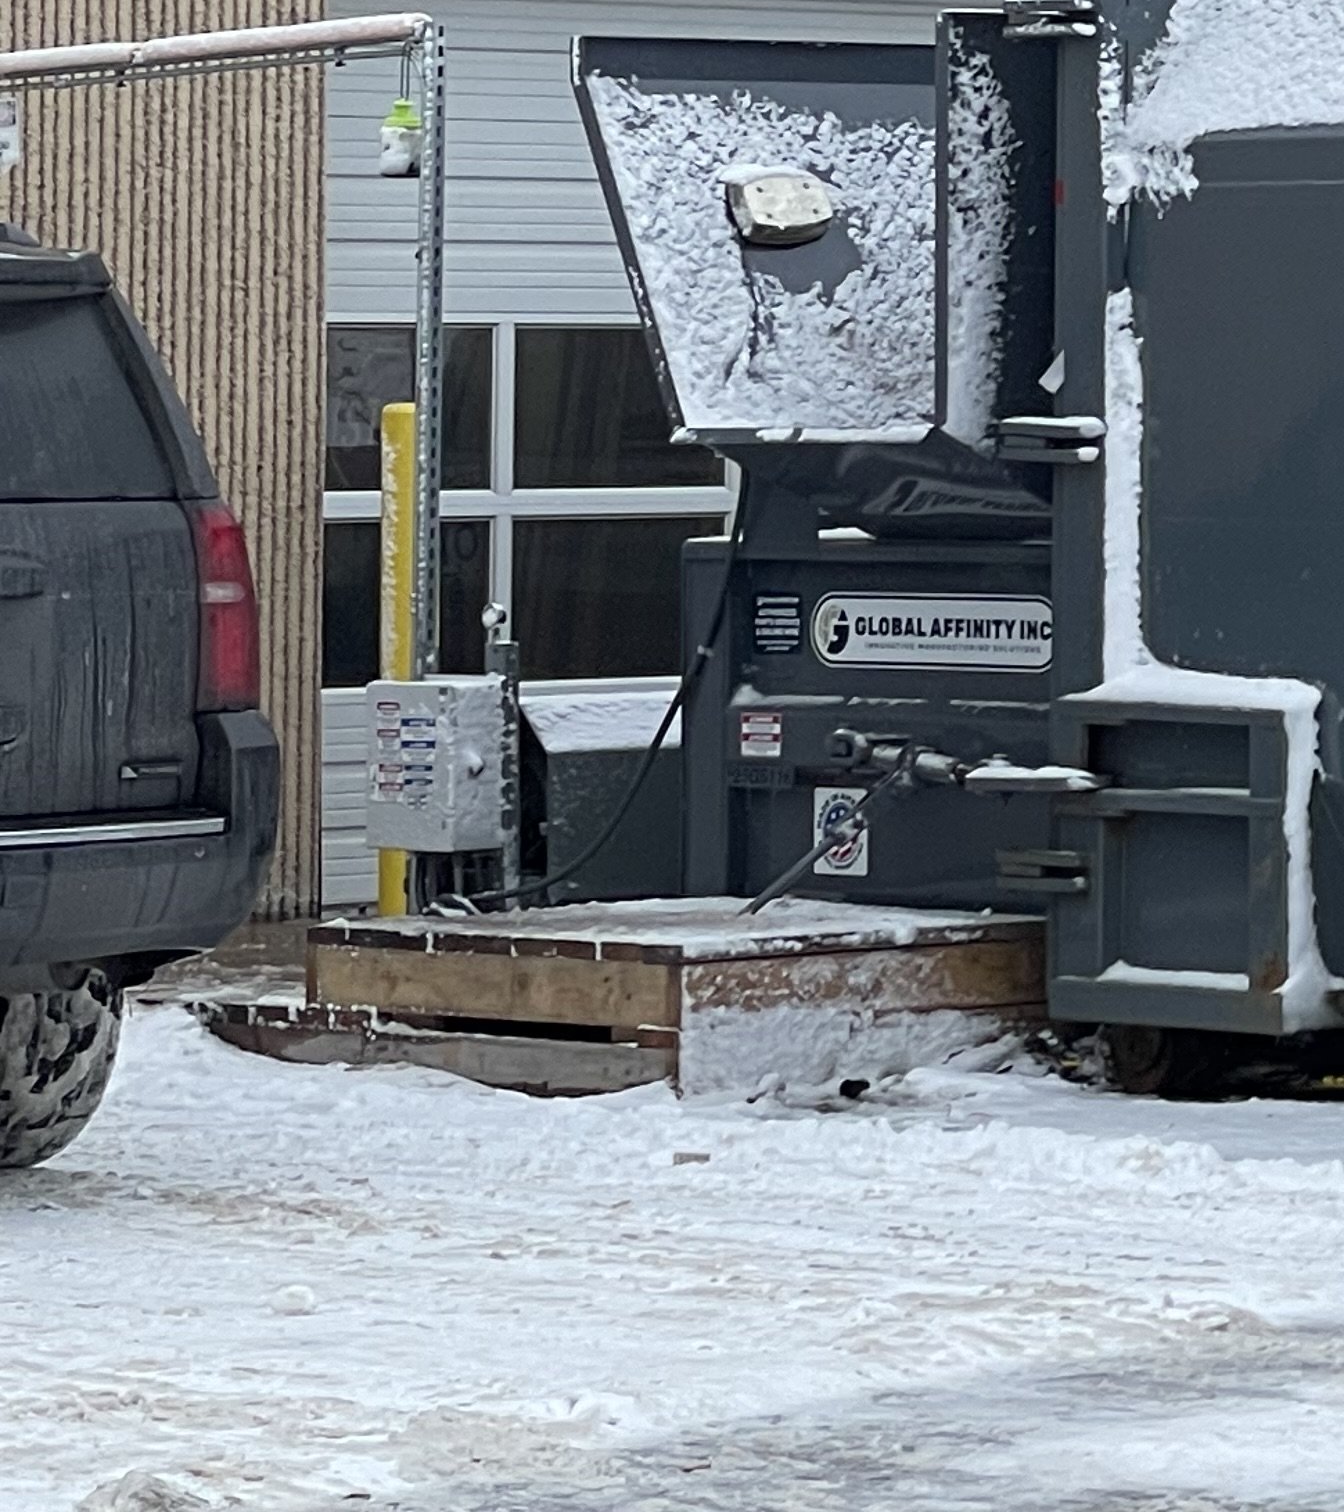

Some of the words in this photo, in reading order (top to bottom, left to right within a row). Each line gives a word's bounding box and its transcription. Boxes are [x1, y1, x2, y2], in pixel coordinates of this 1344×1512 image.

[854, 616, 927, 637] GLOBAL
[929, 618, 1016, 639] AFFINITY
[1020, 620, 1053, 640] INC
